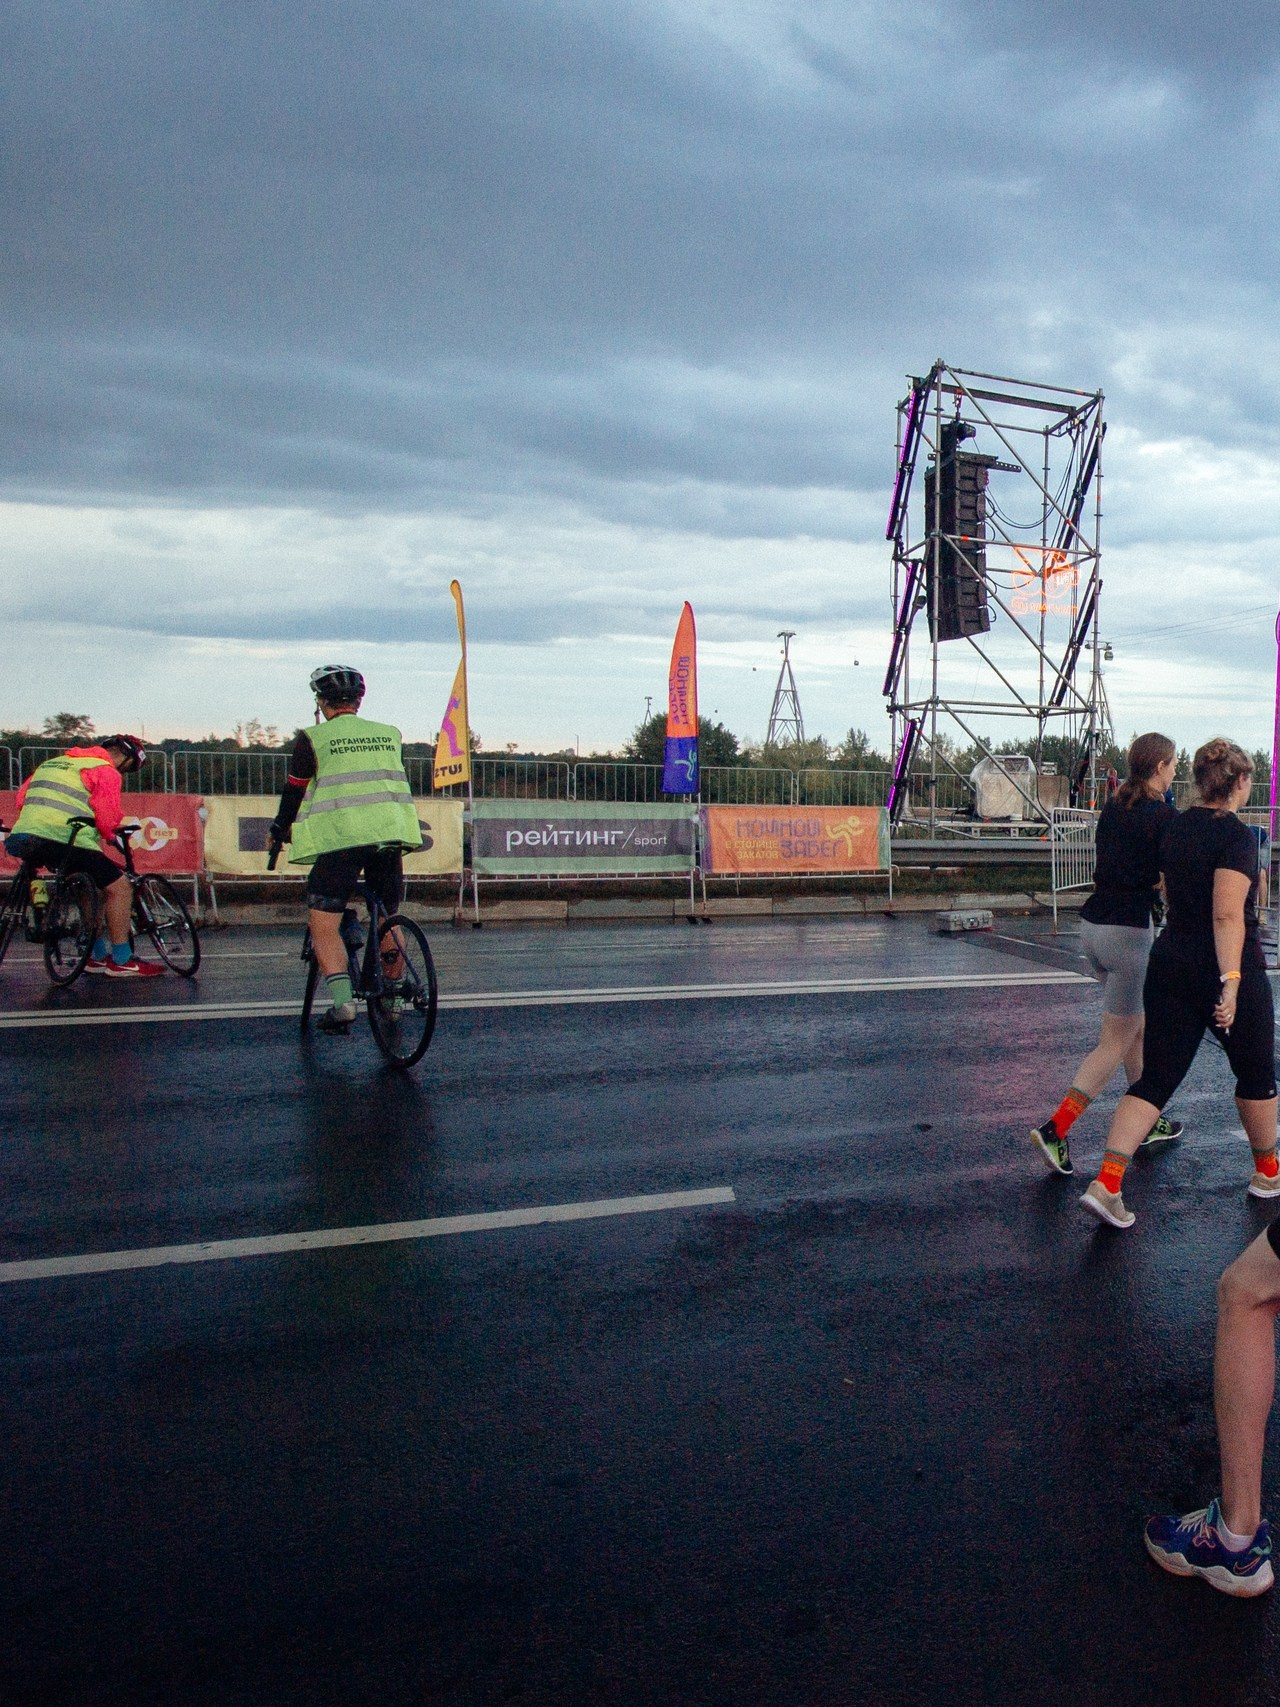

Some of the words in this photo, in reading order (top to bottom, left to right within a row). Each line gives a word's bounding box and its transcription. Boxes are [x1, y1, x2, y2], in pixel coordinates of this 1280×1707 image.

[329, 736, 393, 747] ОРГАНИЗАТОР
[330, 744, 396, 756] МЕРОПРИЯТИЯ
[780, 839, 843, 859] ЗАБЕГ
